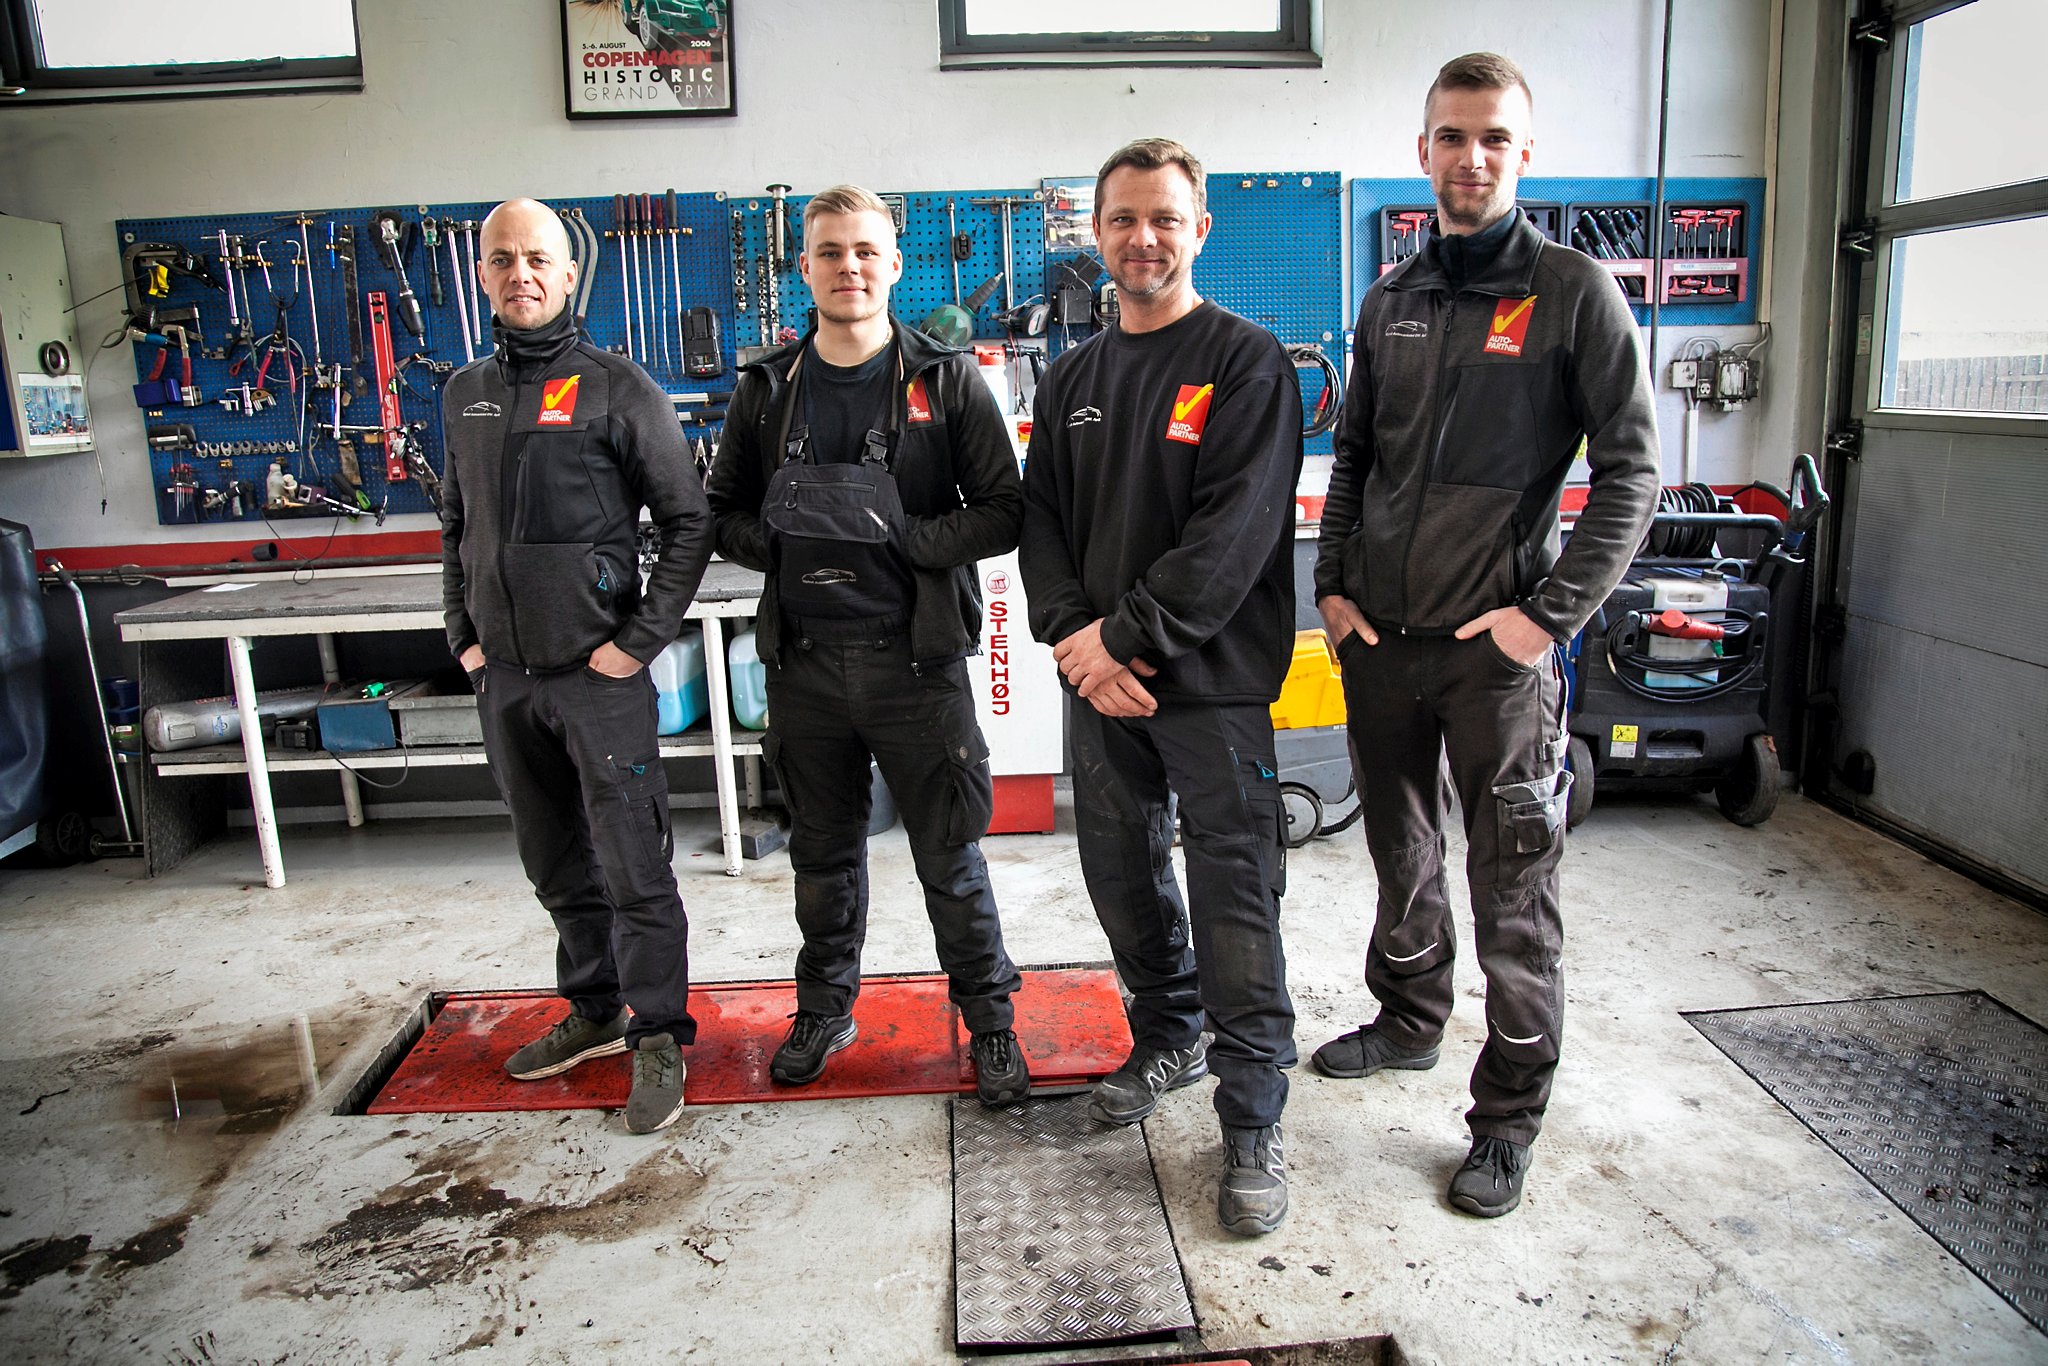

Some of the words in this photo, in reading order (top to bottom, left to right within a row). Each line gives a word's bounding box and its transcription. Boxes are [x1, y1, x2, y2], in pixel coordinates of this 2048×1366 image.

[582, 48, 712, 68] COPENHAGEN
[584, 68, 713, 84] HISTORIC
[584, 86, 658, 101] GRAND
[673, 84, 714, 98] PRIX
[1489, 335, 1513, 344] AUTO-
[1486, 341, 1520, 353] PARTNER
[540, 414, 571, 422] PARTNER
[1170, 422, 1193, 431] AUTO-
[1168, 428, 1200, 442] PARTNER
[989, 601, 1010, 715] STENHØJ
